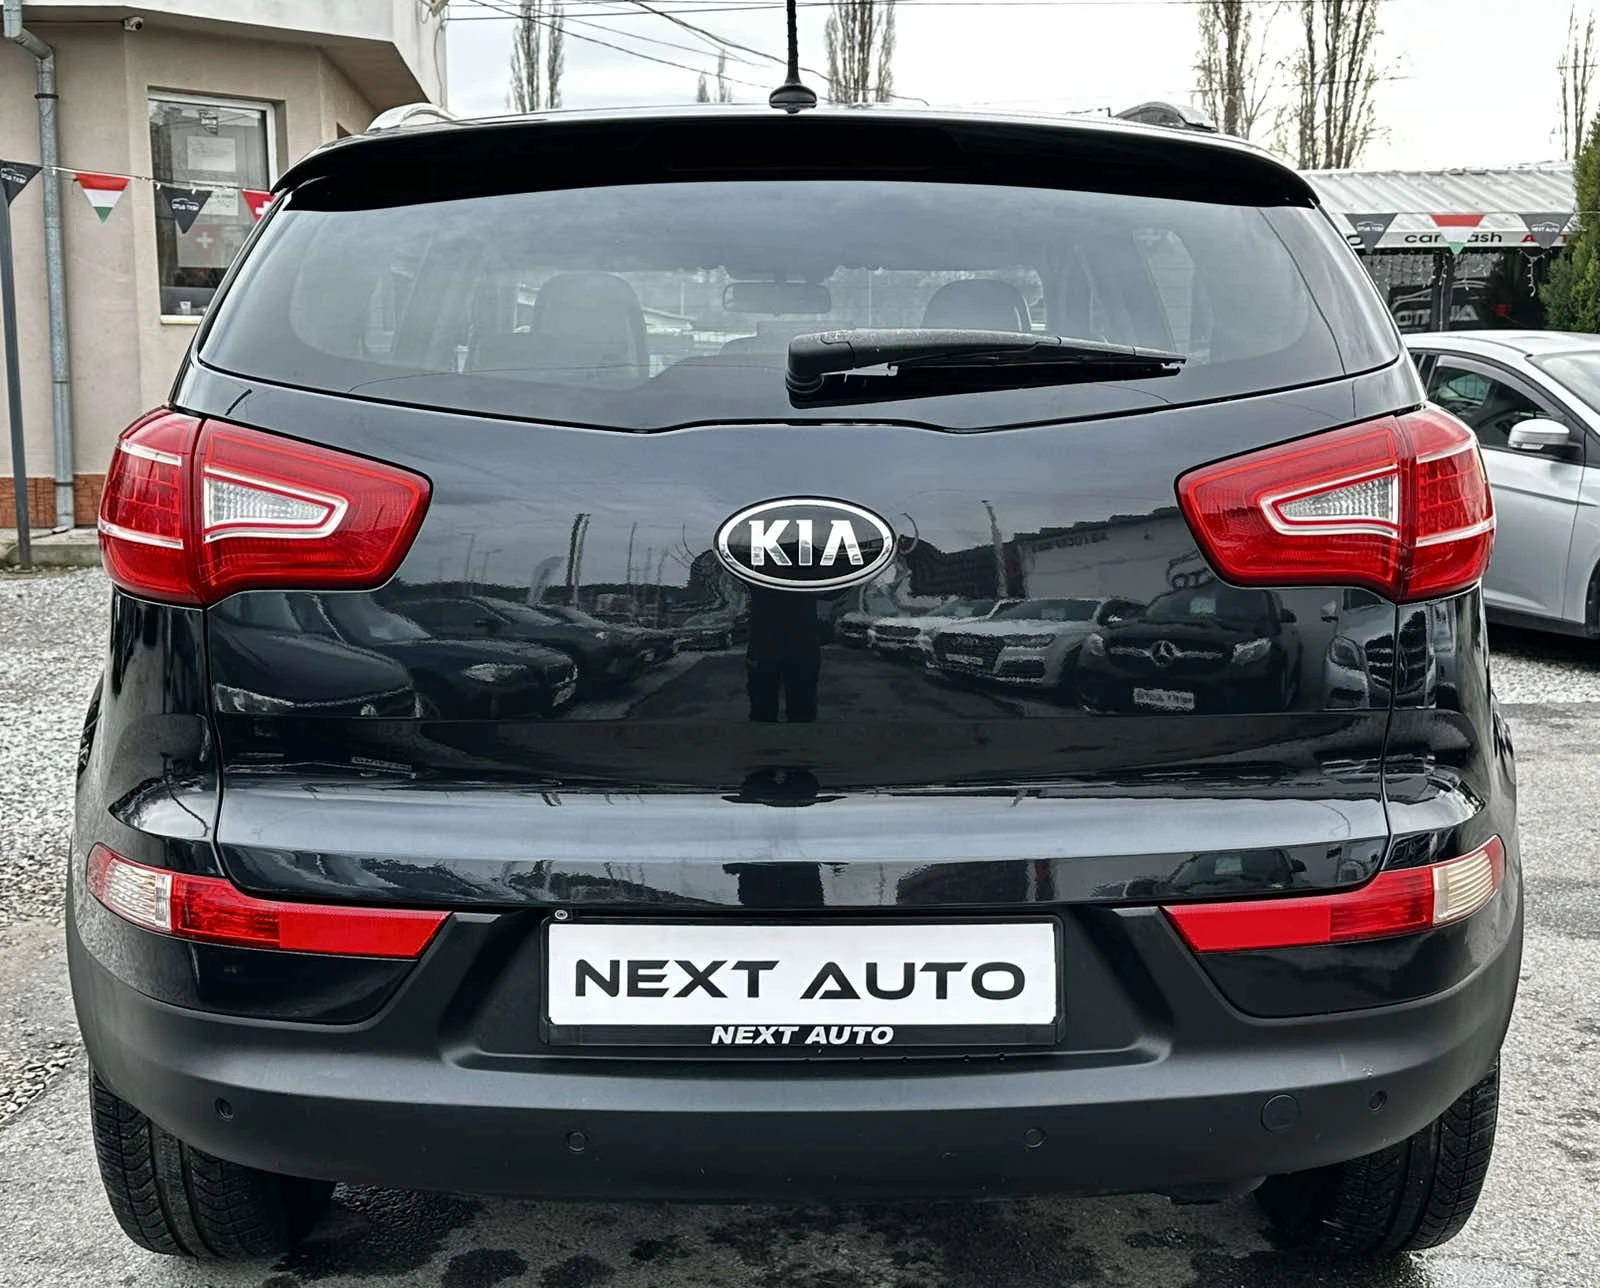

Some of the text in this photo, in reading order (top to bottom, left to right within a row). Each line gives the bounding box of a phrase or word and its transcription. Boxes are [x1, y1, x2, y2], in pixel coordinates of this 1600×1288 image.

[1404, 234, 1441, 244] car
[749, 519, 864, 566] KIA
[575, 959, 1025, 1000] NEXT AUTO
[711, 1026, 895, 1045] NEXT AUTO
